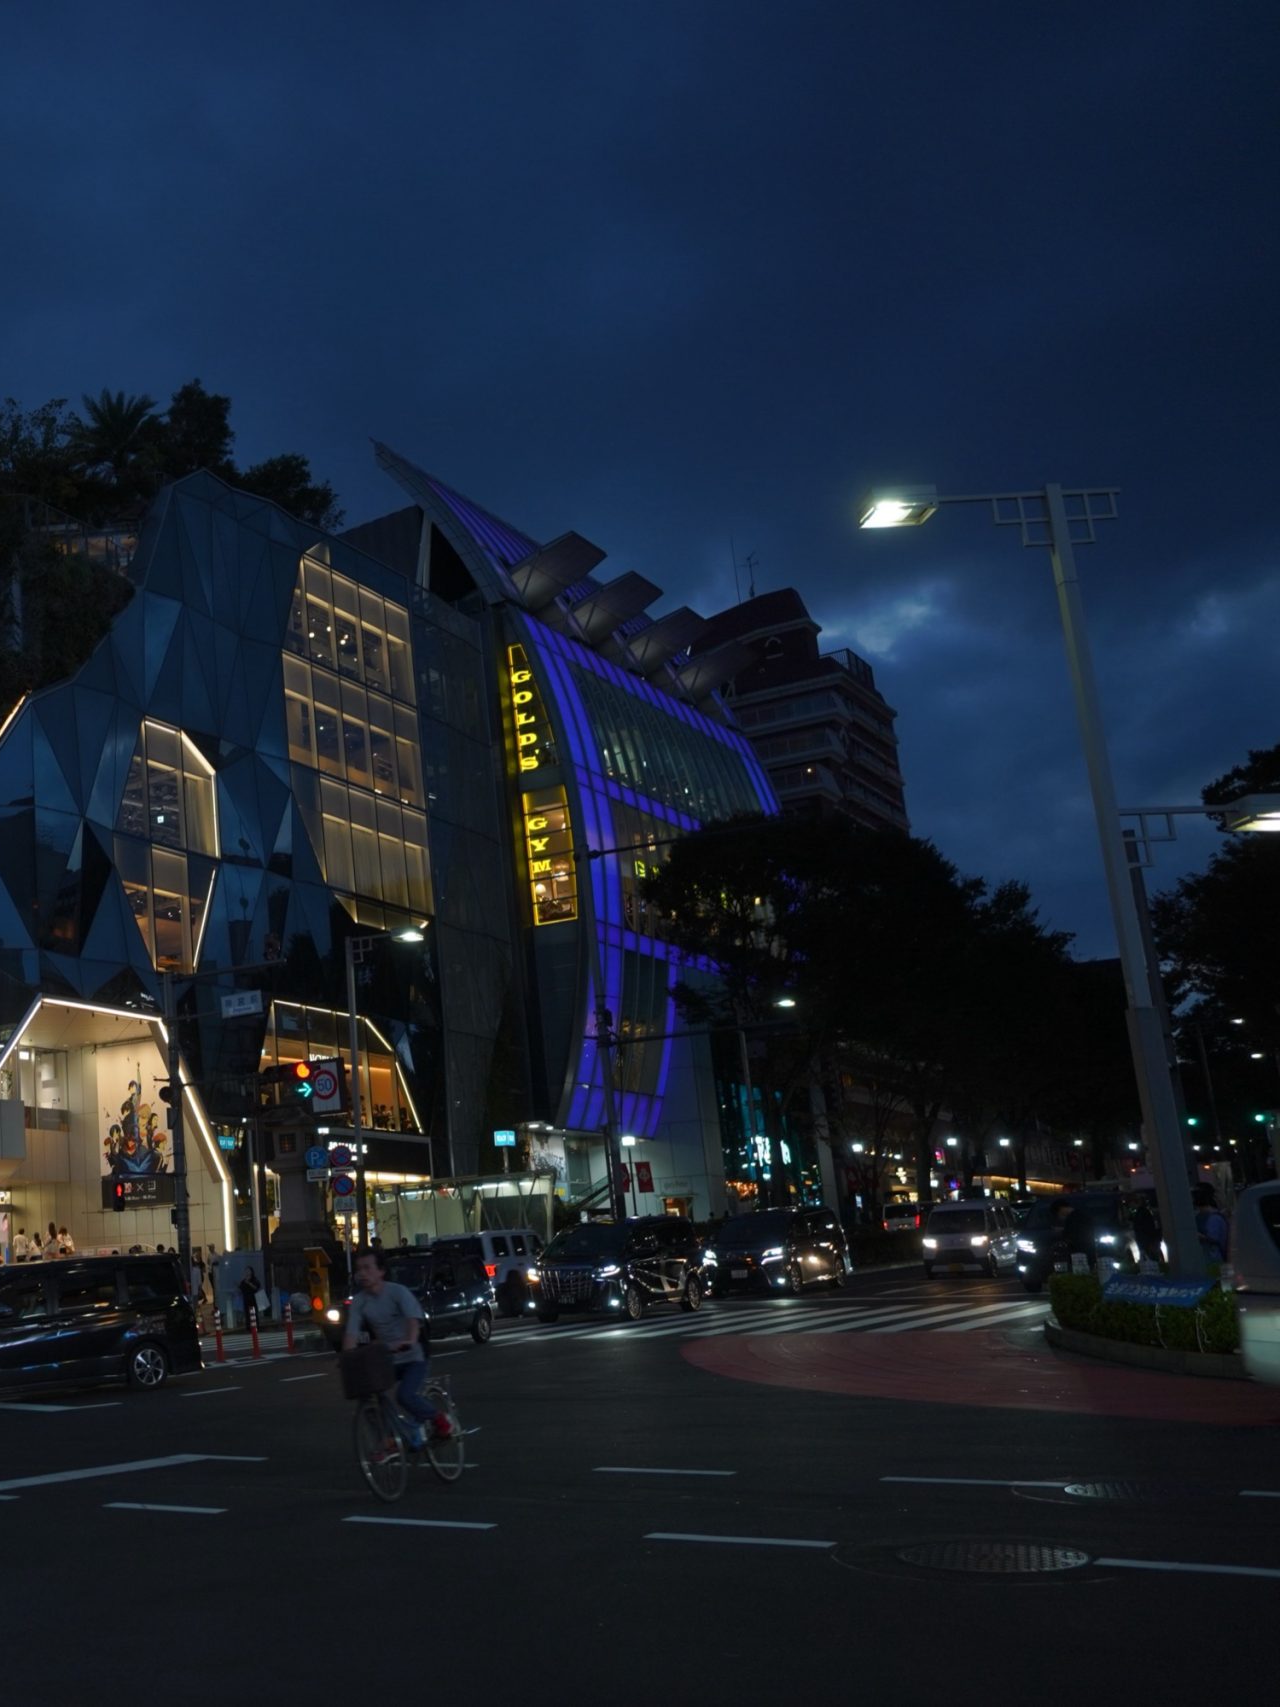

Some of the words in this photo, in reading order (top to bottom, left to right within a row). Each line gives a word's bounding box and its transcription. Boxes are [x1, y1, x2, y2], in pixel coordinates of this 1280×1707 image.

[511, 669, 539, 773] GOLD'S
[527, 817, 552, 874] GYM
[317, 1078, 333, 1092] 50
